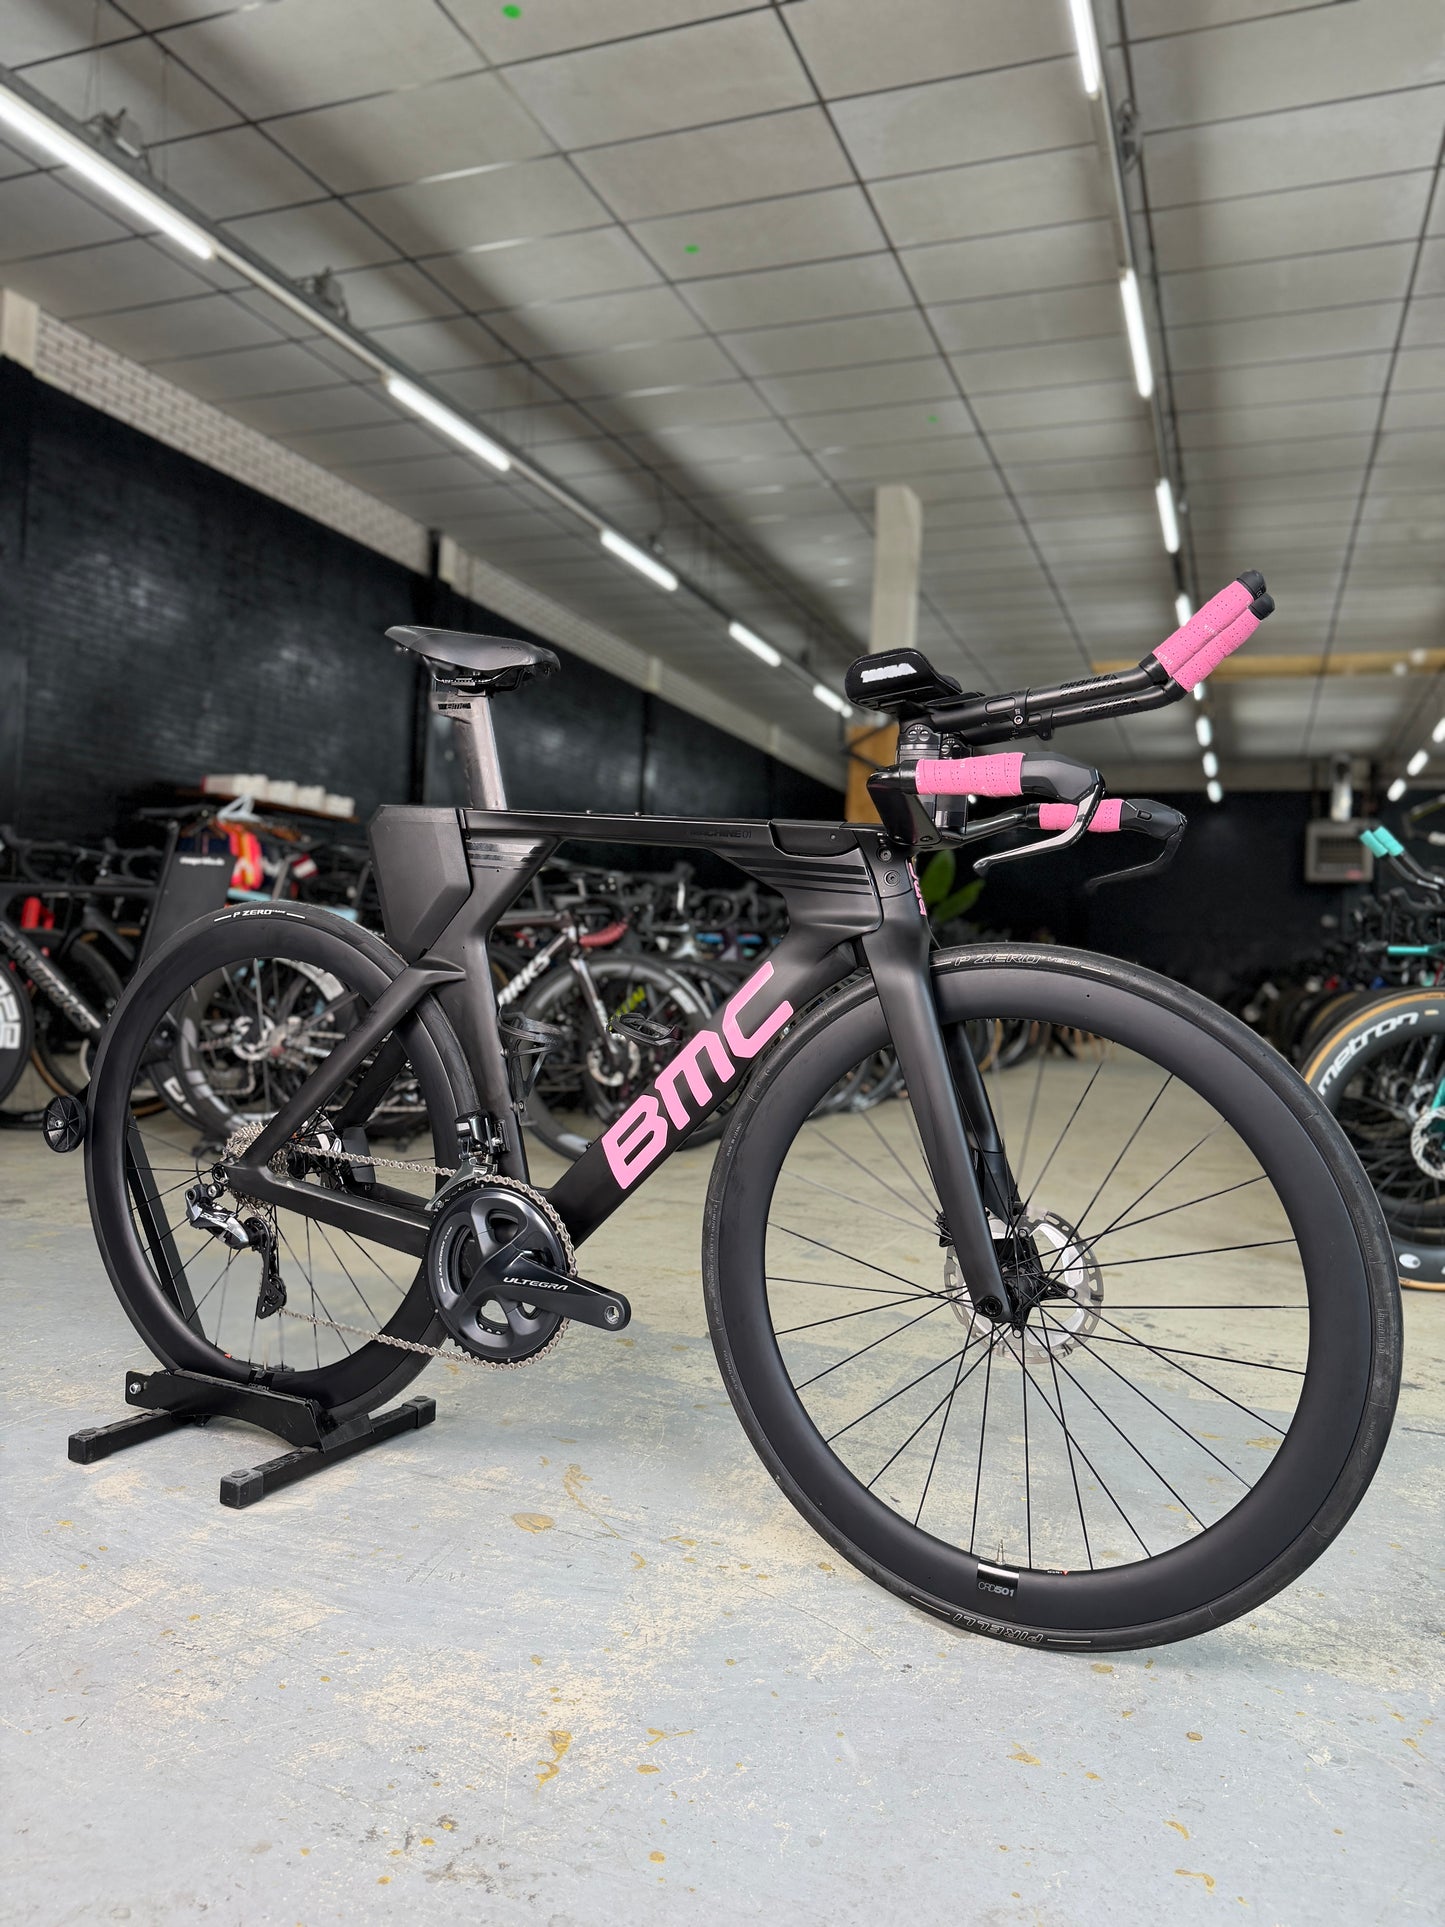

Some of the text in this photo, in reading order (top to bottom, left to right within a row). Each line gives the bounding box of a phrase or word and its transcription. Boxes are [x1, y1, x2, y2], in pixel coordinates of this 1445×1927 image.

[242, 909, 272, 917] ZERO
[955, 955, 972, 966] P
[974, 953, 1042, 965] ZERO
[1317, 1011, 1419, 1096] metron
[601, 960, 794, 1190] BMC
[503, 1276, 569, 1291] ULTEGRA
[953, 1613, 1043, 1643] PIRELLI
